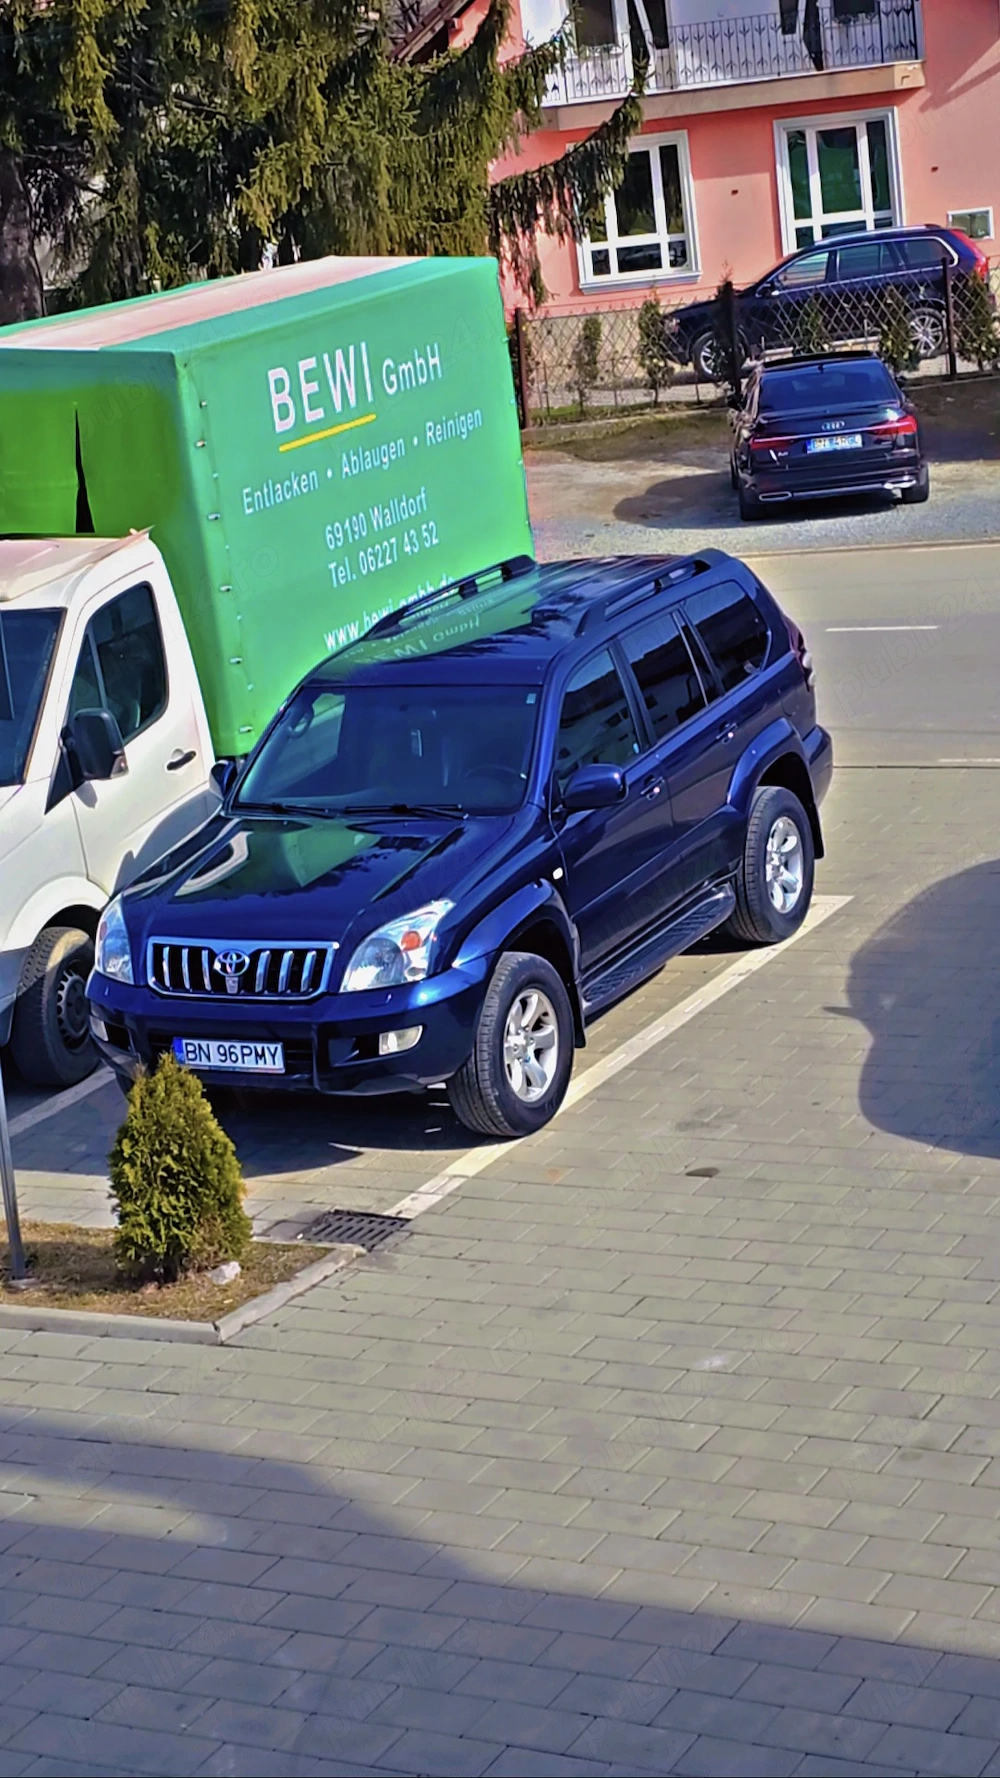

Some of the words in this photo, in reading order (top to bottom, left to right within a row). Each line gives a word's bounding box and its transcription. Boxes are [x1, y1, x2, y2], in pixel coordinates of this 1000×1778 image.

[268, 341, 374, 433] BEWI
[382, 342, 443, 395] GmbH
[242, 470, 319, 515] Entlacken
[341, 437, 406, 479] Ablaugen
[426, 409, 483, 447] Reinigen
[325, 512, 367, 550] 69190
[369, 486, 427, 532] Walldorf
[328, 556, 357, 588] Tel.
[359, 537, 398, 575] 06227
[404, 529, 420, 555] 43
[421, 520, 439, 548] 52
[184, 1042, 212, 1063] BN
[217, 1044, 279, 1066] 96PMY
